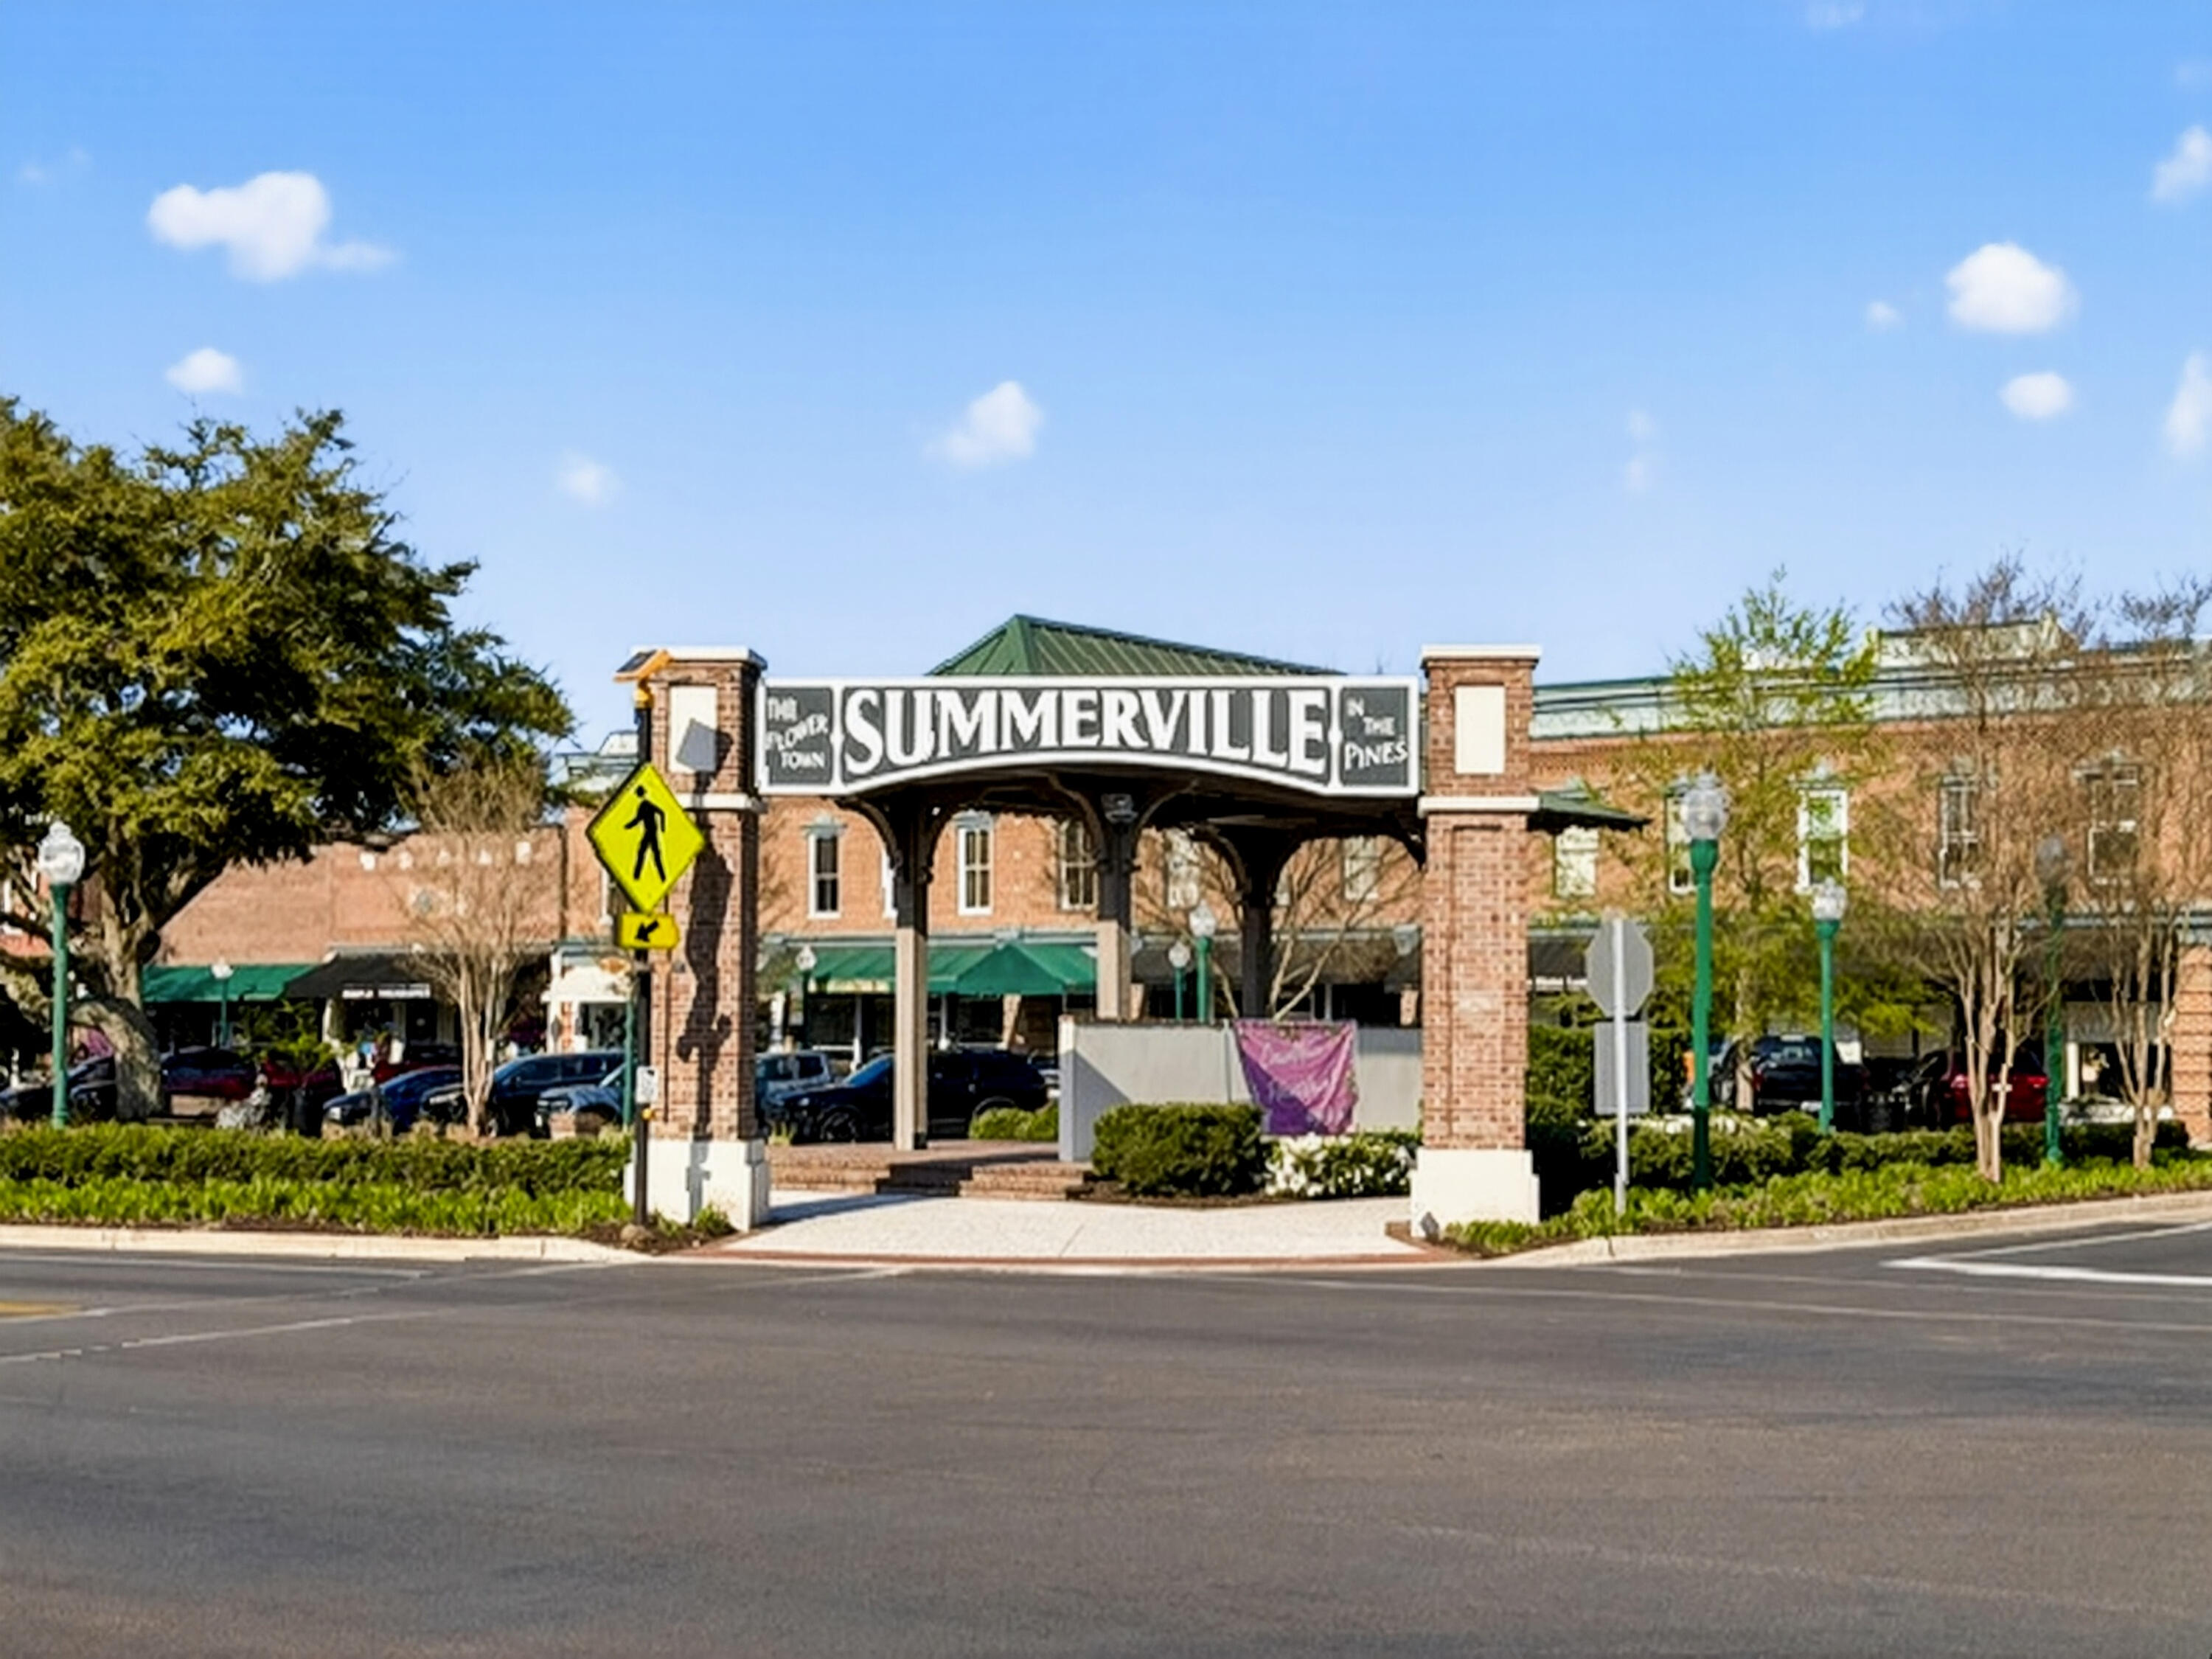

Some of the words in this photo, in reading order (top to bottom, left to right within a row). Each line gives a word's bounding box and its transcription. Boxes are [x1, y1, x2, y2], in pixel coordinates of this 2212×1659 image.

[844, 689, 1326, 775] SUMMERVILLE
[782, 752, 825, 770] TOWN
[1344, 739, 1408, 770] PINES
